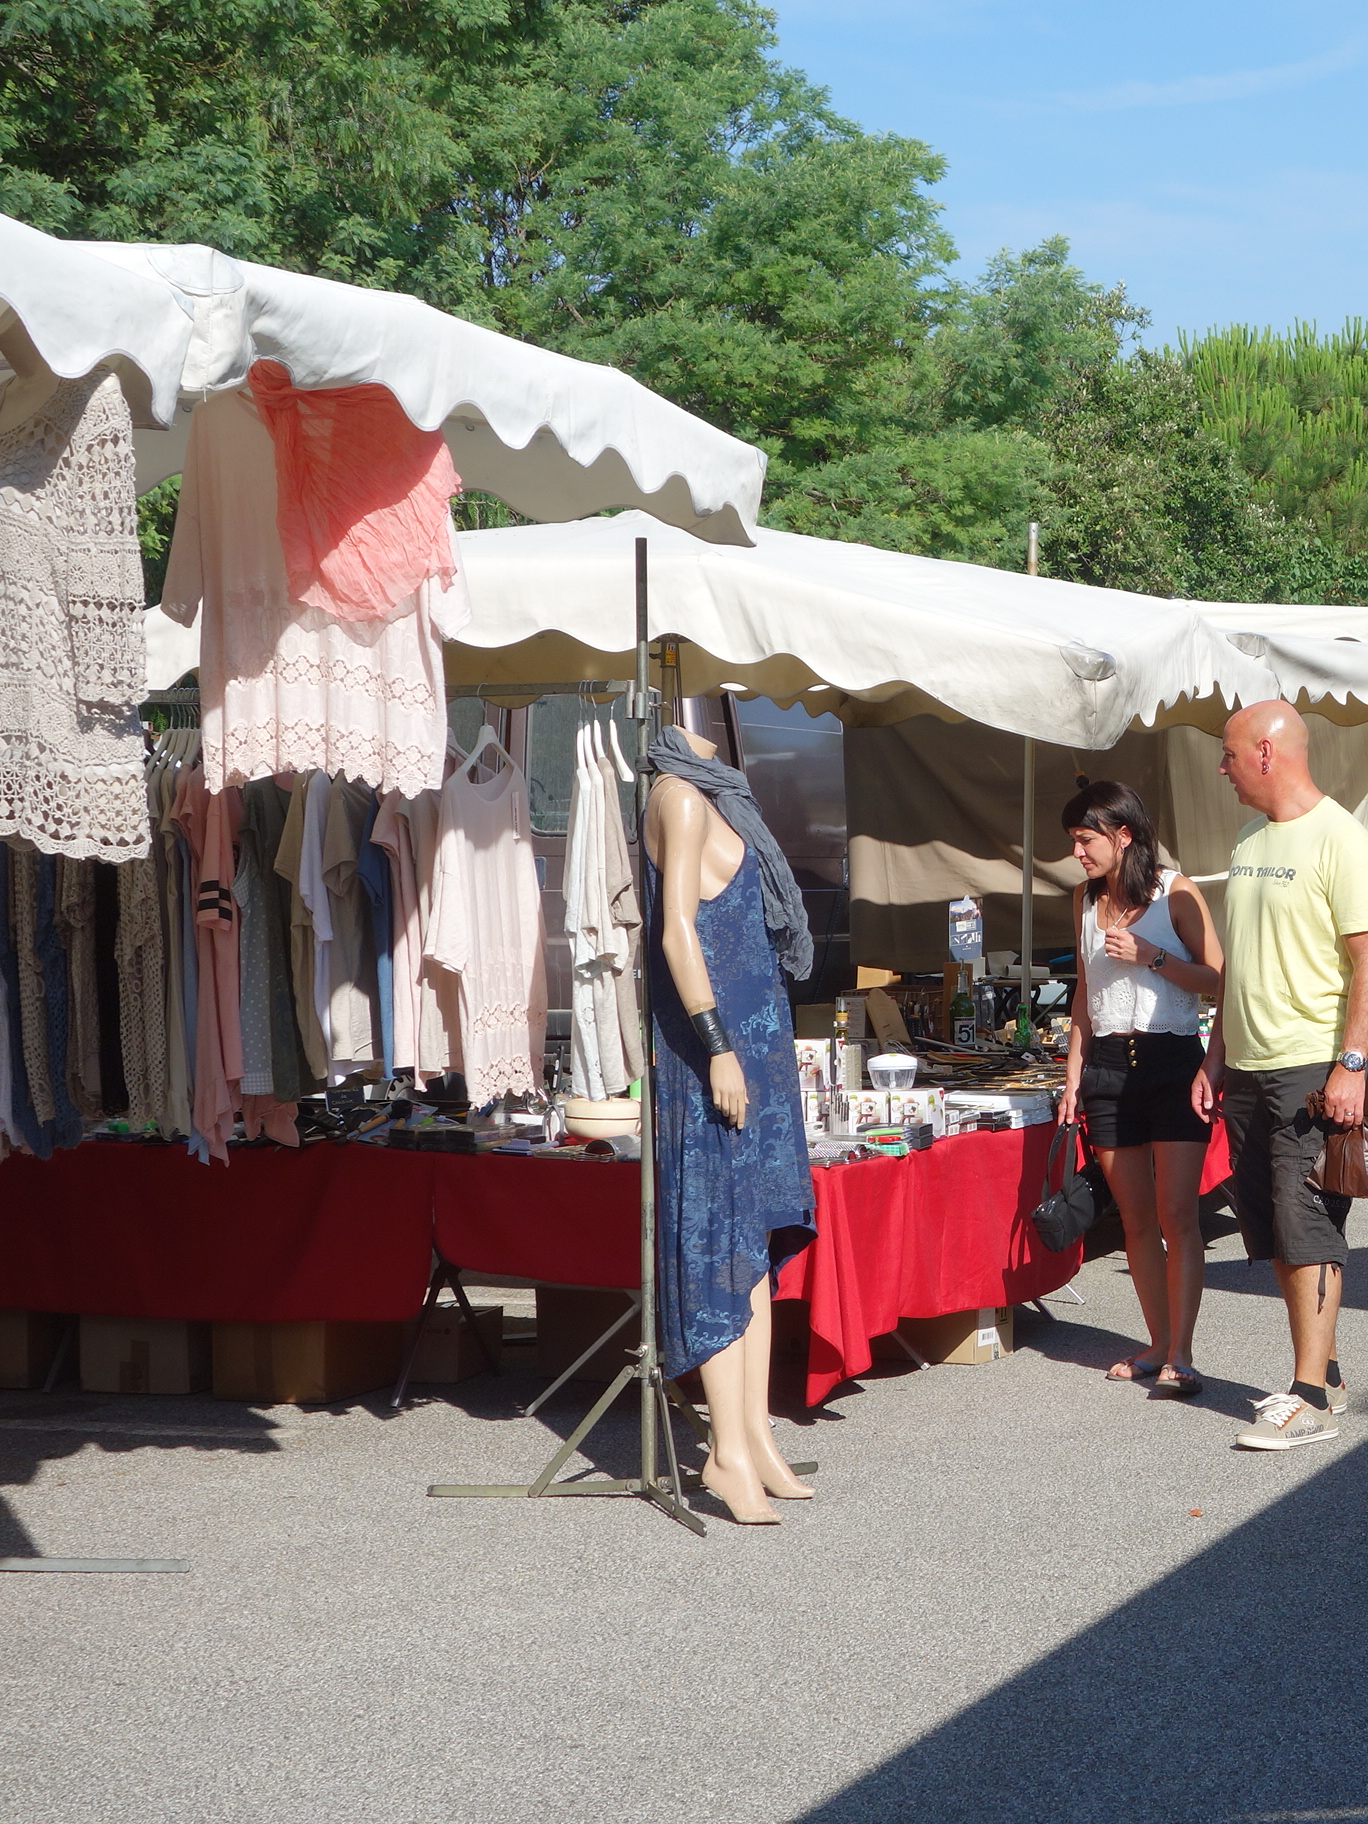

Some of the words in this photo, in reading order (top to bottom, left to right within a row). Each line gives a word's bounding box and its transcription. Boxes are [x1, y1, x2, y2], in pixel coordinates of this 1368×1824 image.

[1256, 866, 1297, 881] TAILOR
[957, 1024, 975, 1043] 51
[1285, 1428, 1306, 1438] CAMP
